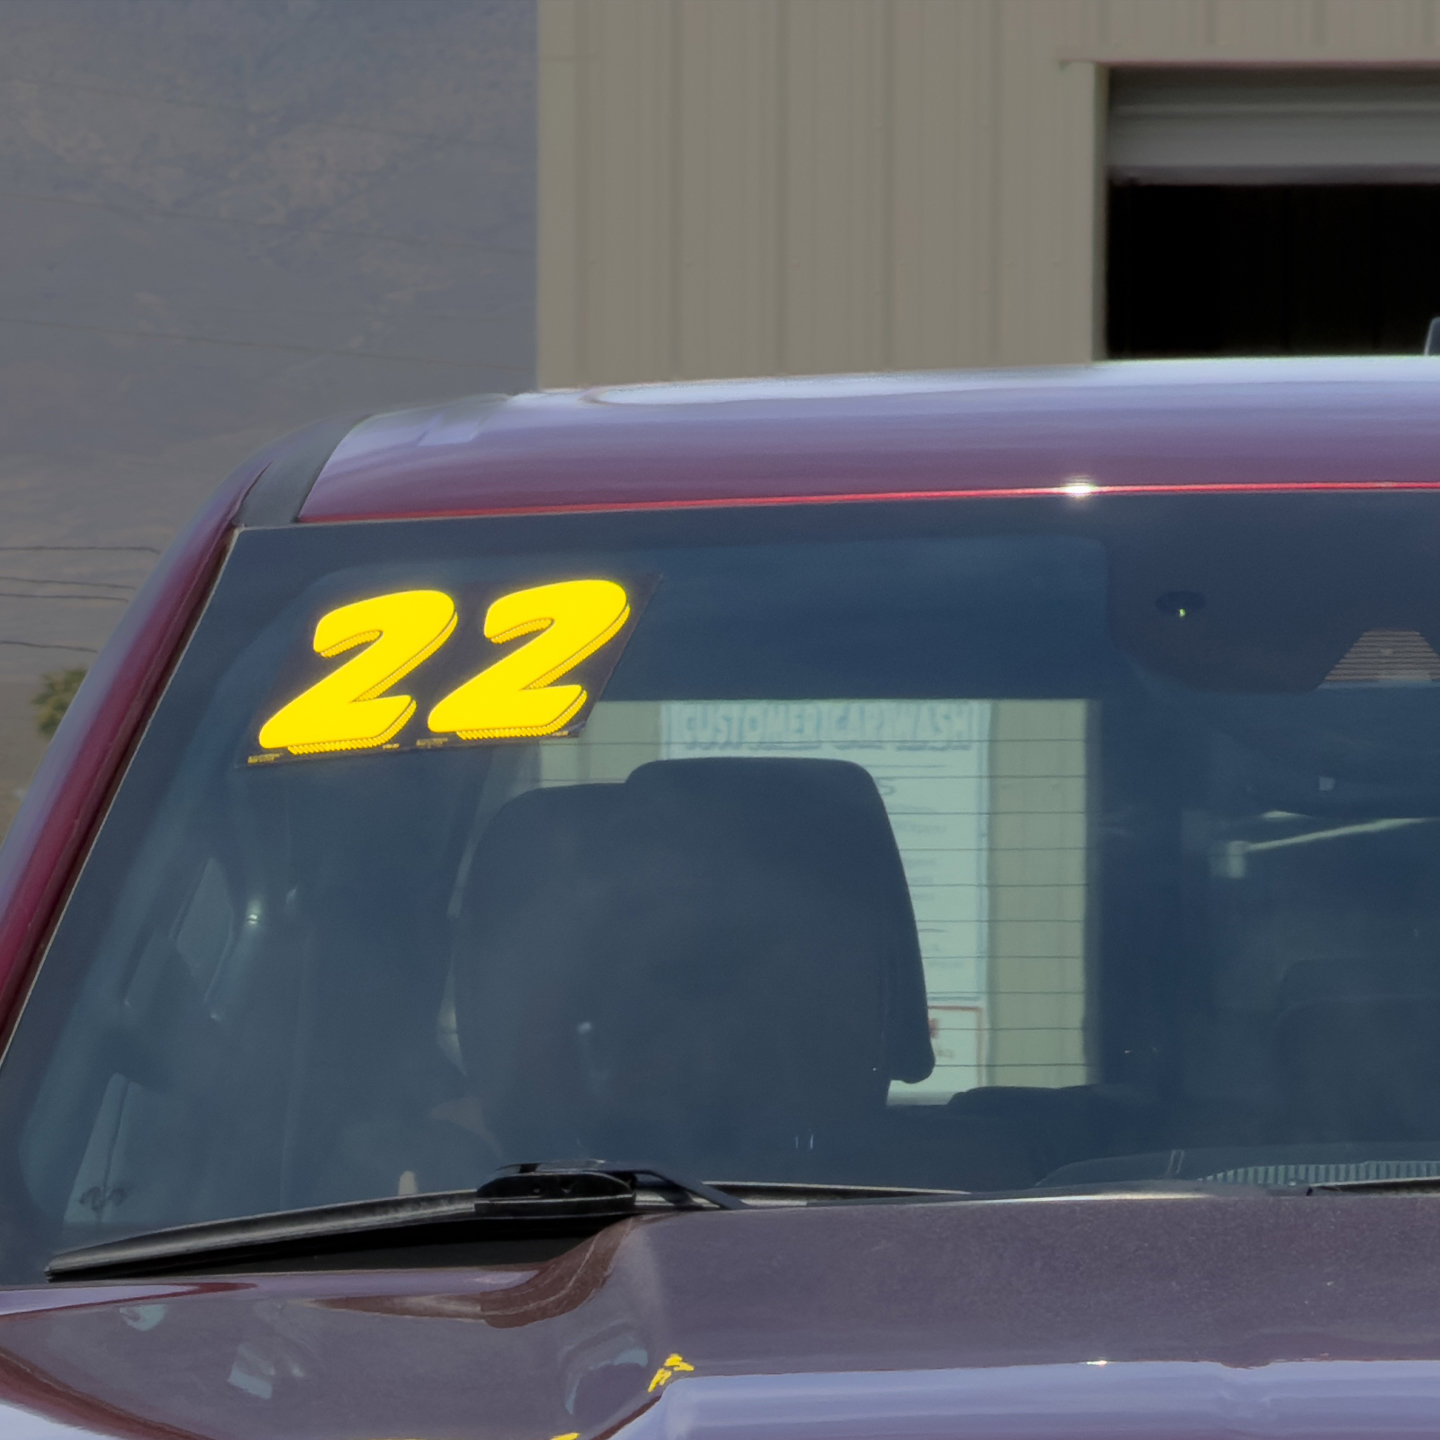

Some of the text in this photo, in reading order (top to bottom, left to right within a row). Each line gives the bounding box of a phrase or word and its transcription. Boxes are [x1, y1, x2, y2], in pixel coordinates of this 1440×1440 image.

[258, 579, 630, 756] 22
[679, 702, 971, 751] CUSTOMER CAR WASH
